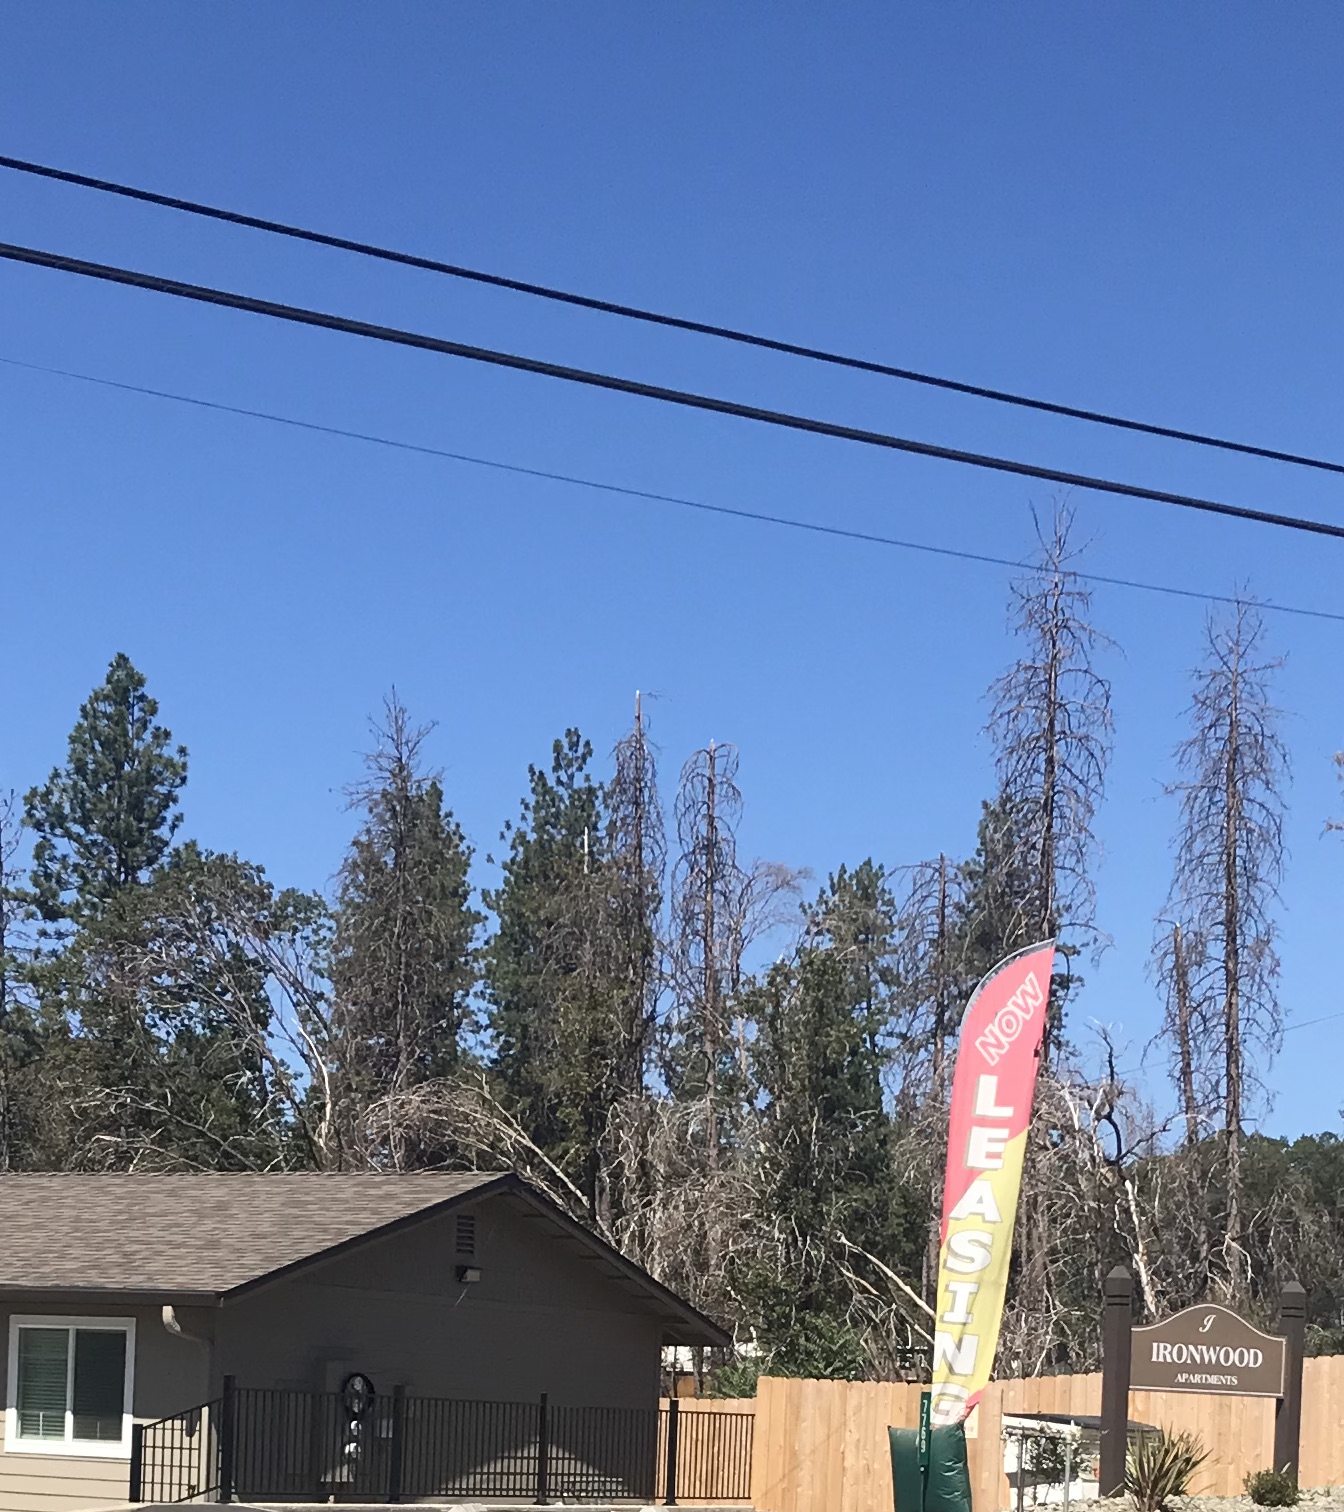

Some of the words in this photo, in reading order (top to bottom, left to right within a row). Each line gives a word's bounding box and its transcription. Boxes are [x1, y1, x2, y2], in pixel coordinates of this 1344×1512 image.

[975, 971, 1043, 1066] NOW
[930, 1074, 1014, 1427] LEASING
[1151, 1342, 1263, 1368] IRONWOOD
[1175, 1373, 1238, 1385] APARTMENTS
[920, 1399, 928, 1453] 7769
